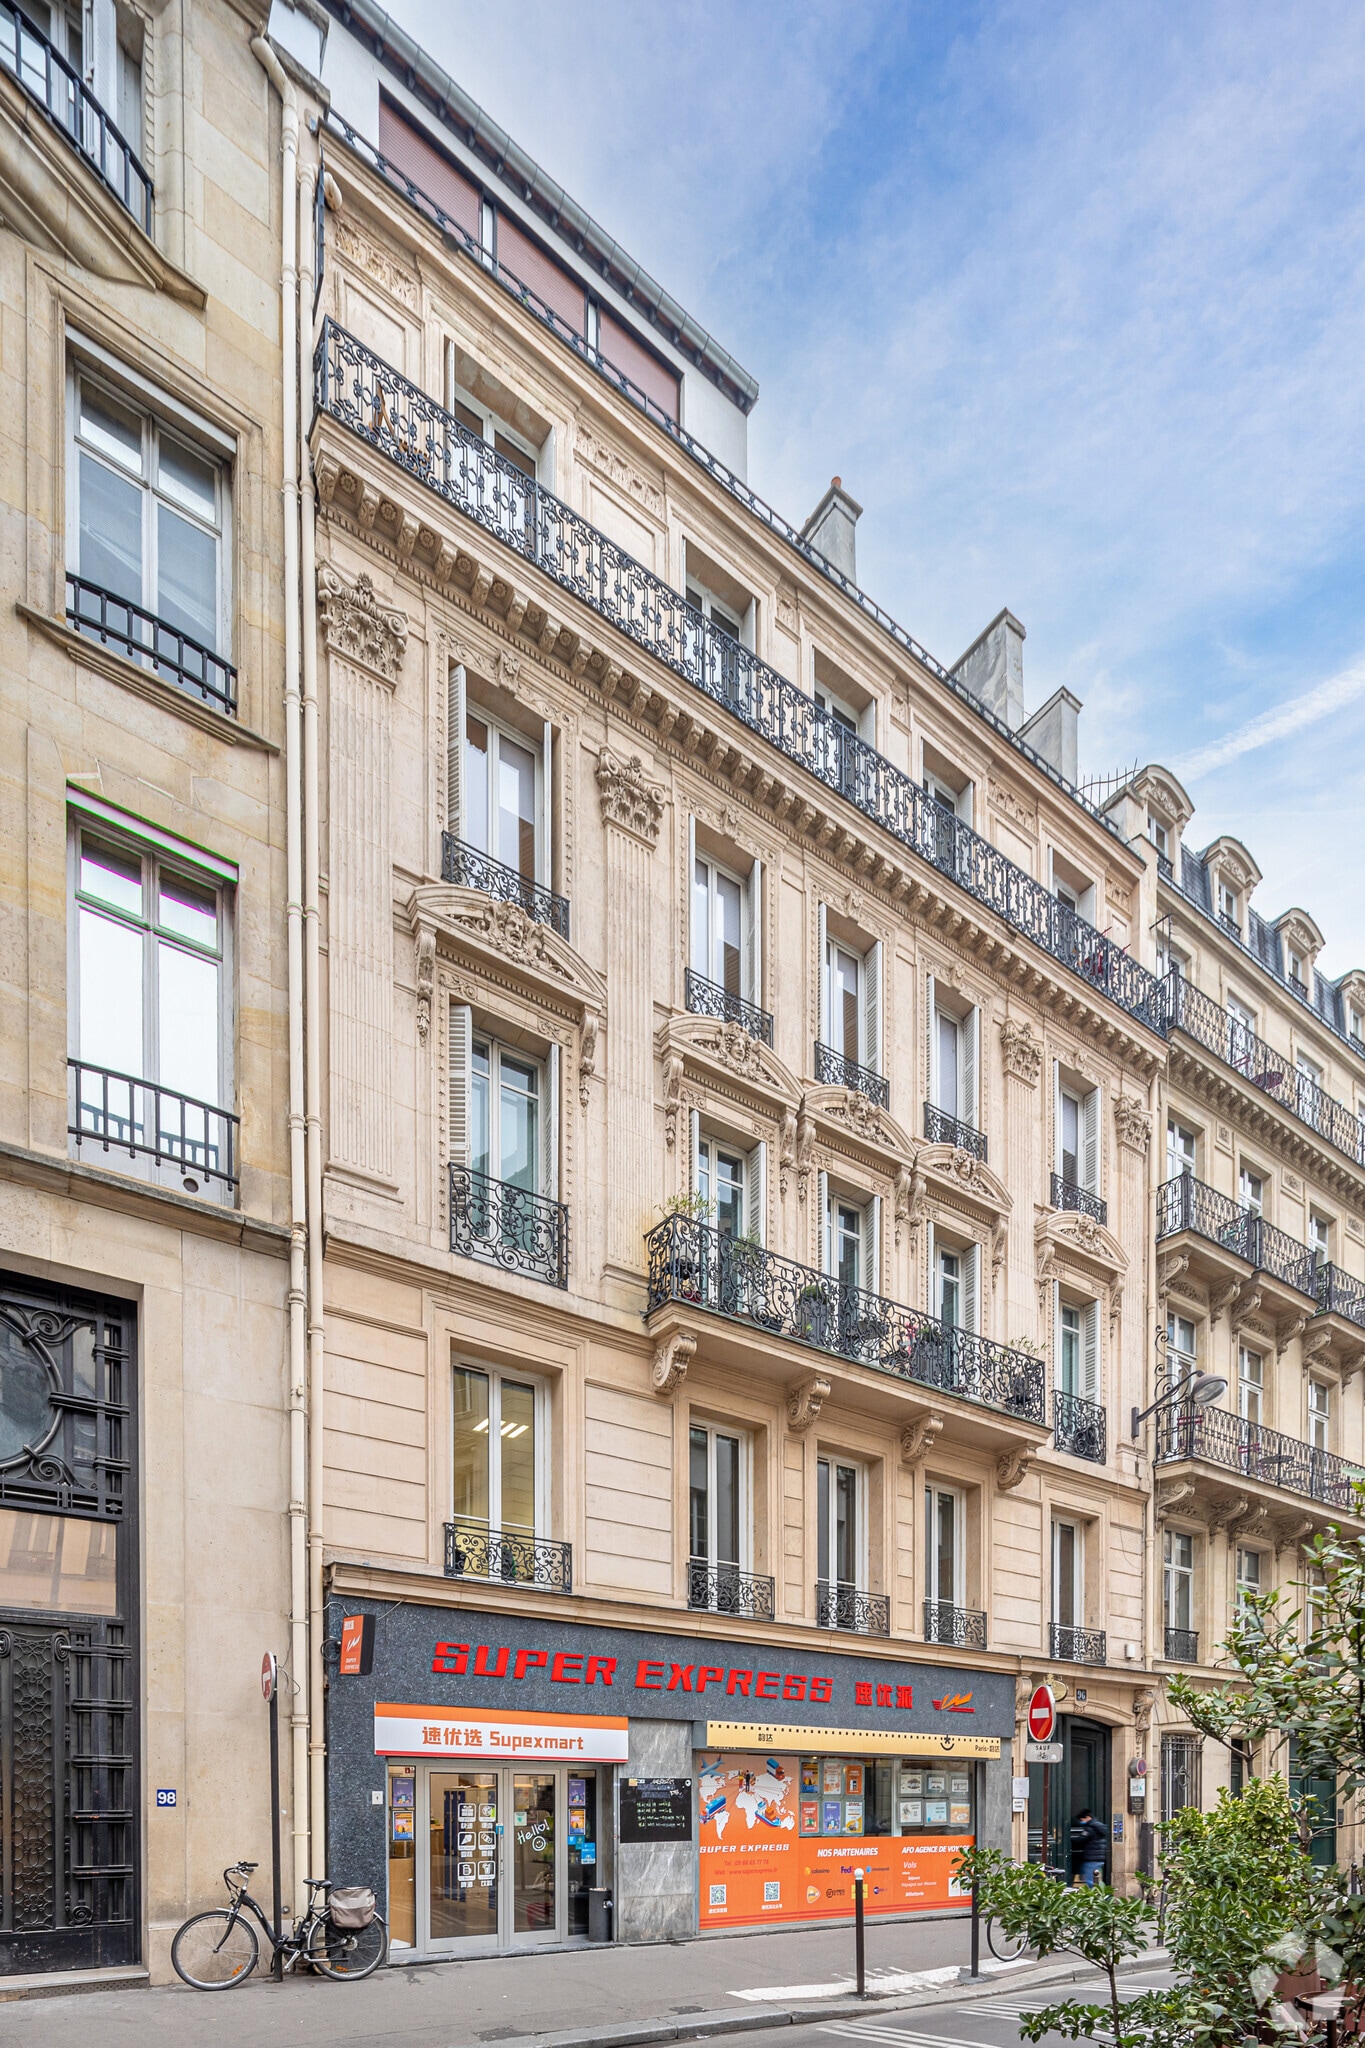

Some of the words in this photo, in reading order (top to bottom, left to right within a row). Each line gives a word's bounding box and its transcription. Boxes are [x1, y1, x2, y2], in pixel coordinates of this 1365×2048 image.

[432, 1641, 617, 1686] SUPER
[634, 1659, 834, 1703] EXPRESS
[855, 1681, 913, 1709] 速优派
[1077, 1689, 1086, 1700] 96
[422, 1726, 482, 1747] 速优选
[489, 1730, 584, 1751] Supexmart
[157, 1791, 176, 1805] 98
[517, 1818, 550, 1845] Hello!
[699, 1845, 737, 1854] SUPER
[740, 1843, 789, 1852] EXPRESS
[817, 1849, 832, 1857] NOS
[833, 1847, 878, 1857] PARTENAIRES
[902, 1846, 914, 1854] AFO
[915, 1845, 938, 1853] AGENCE
[903, 1861, 917, 1869] Vols
